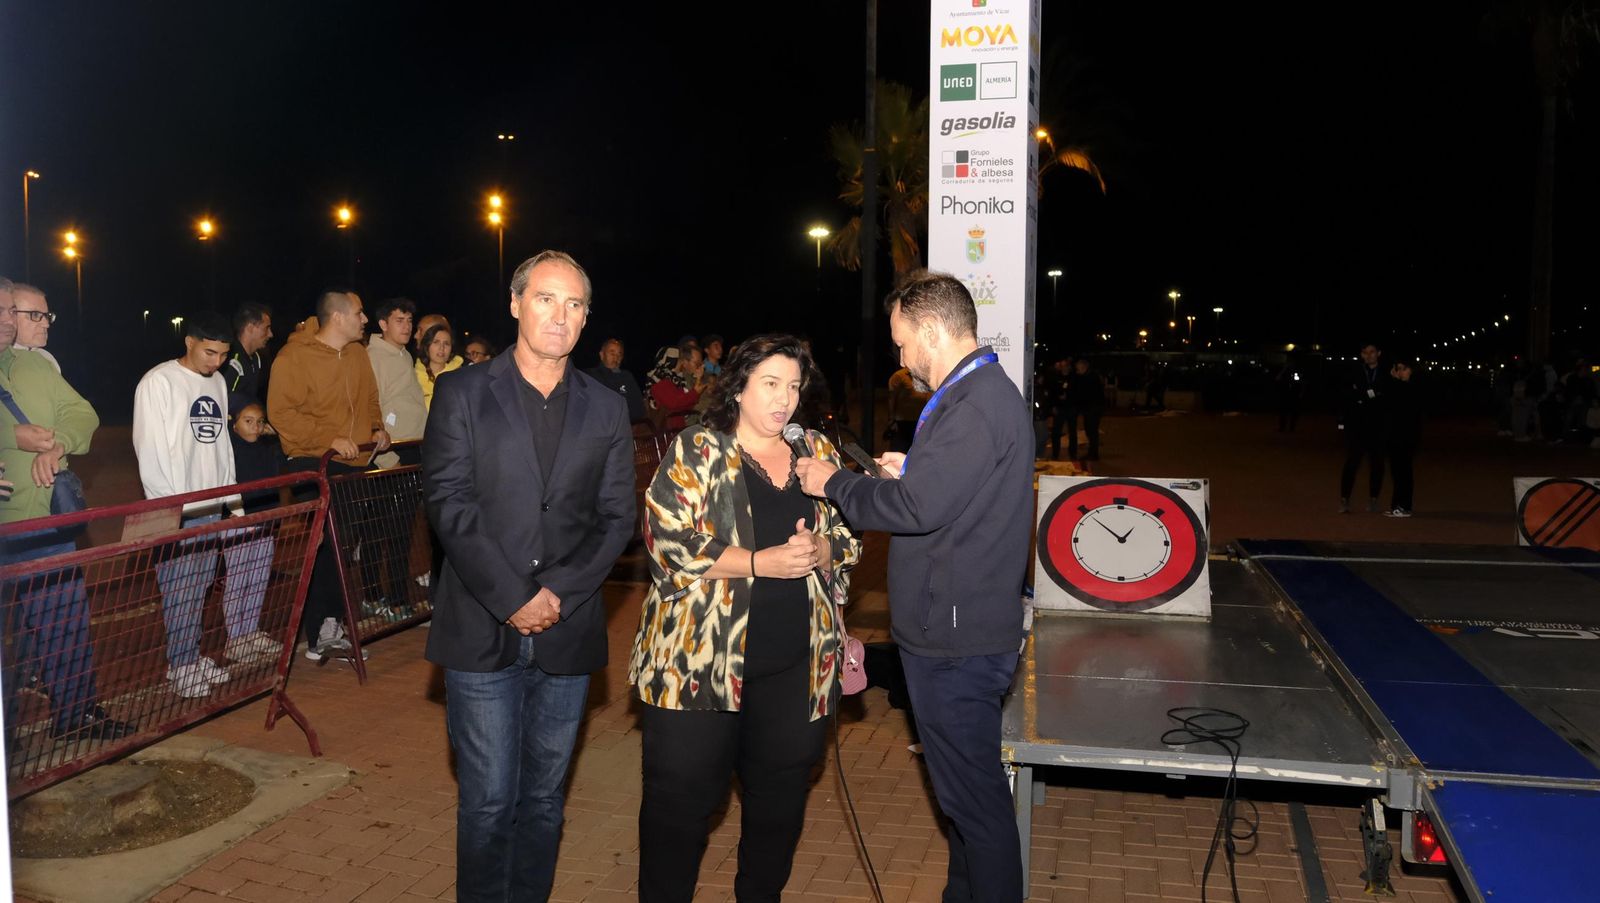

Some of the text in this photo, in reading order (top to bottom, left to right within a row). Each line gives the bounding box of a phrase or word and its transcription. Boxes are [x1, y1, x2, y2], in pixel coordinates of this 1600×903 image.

[941, 24, 1018, 48] MOYA
[943, 77, 973, 88] UNED
[940, 111, 1016, 136] gasolia
[970, 149, 990, 157] Grupo
[970, 157, 1014, 166] Fornieles
[970, 167, 1014, 177] & albesa
[941, 195, 1014, 215] Phonika
[198, 400, 214, 415] N
[198, 424, 215, 438] S
